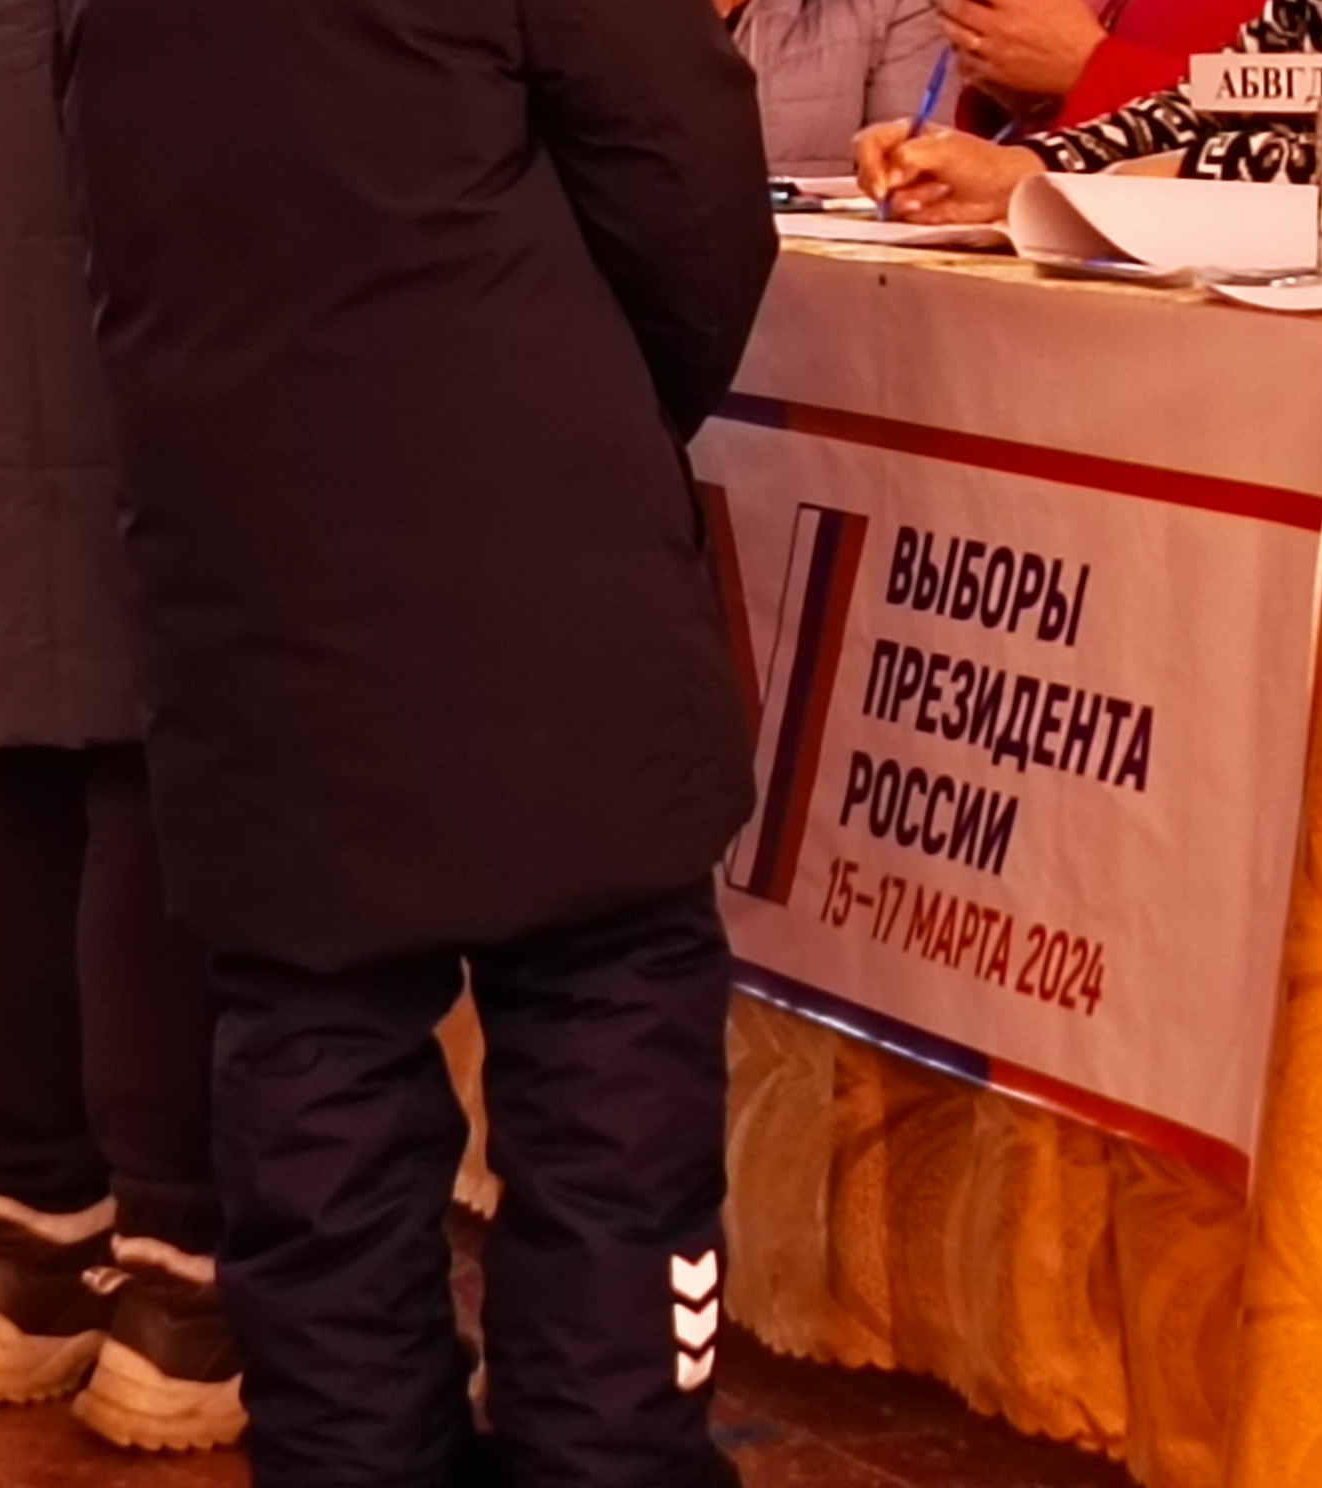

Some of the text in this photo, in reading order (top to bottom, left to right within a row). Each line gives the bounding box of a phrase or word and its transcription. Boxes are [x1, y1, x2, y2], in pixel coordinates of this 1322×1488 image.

[886, 525, 1091, 647] ВЫБОРЫ
[862, 638, 1155, 793] ПРЕЗИДЕНТА
[838, 750, 1019, 876] РОССИИ
[820, 856, 1105, 1016] 15–17 МАРТА 2024
